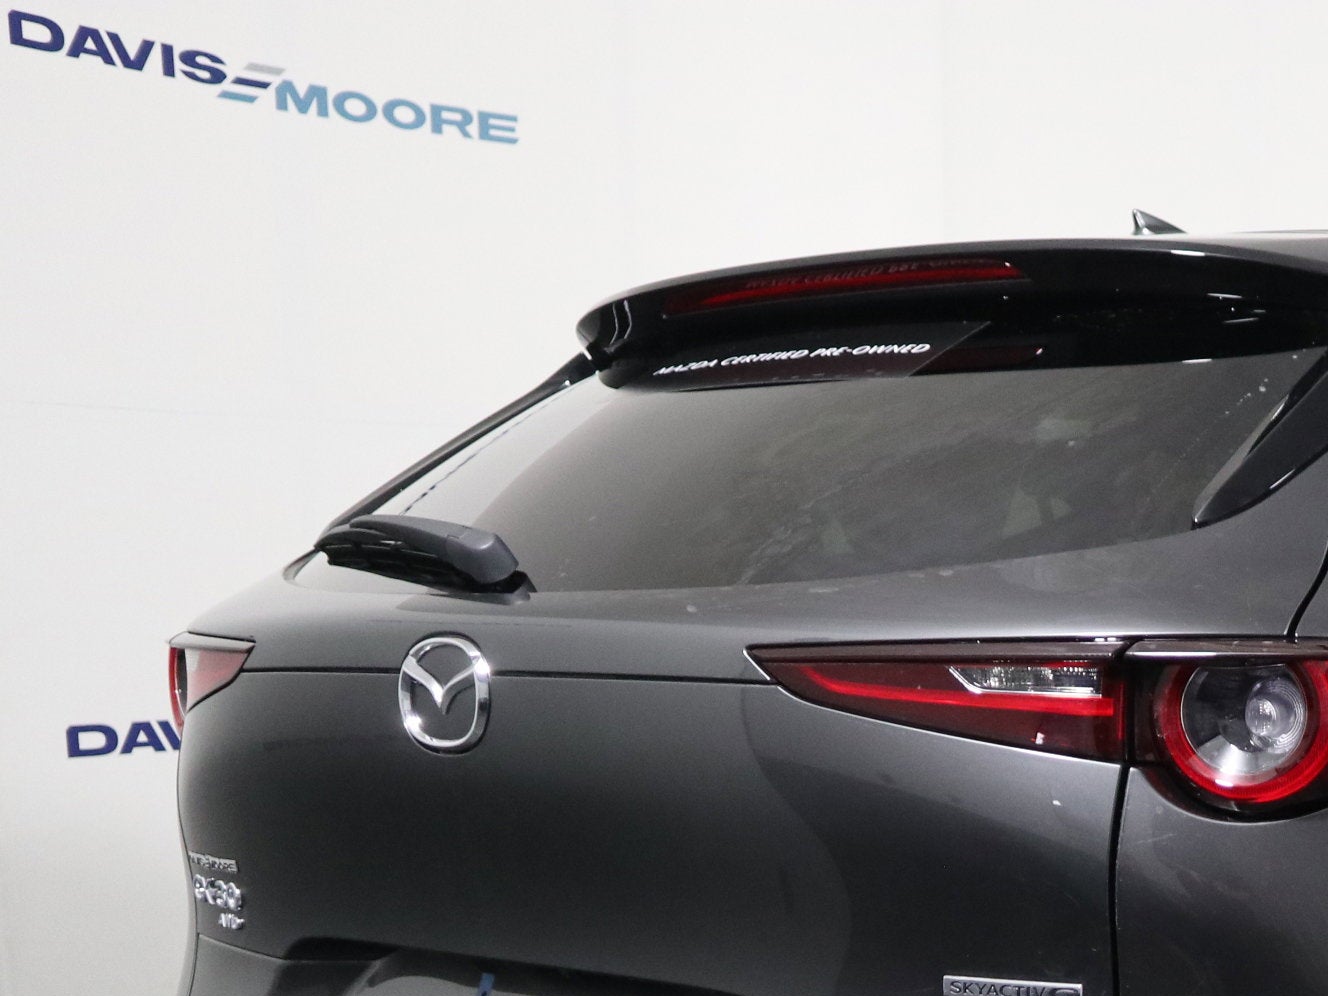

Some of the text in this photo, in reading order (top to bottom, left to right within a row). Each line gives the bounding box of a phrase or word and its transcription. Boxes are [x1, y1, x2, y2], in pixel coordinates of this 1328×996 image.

[8, 9, 519, 144] DAVIS MOORE
[653, 343, 931, 376] MAZDA CERTIFIED PRE-OWNED
[66, 720, 181, 758] DAV
